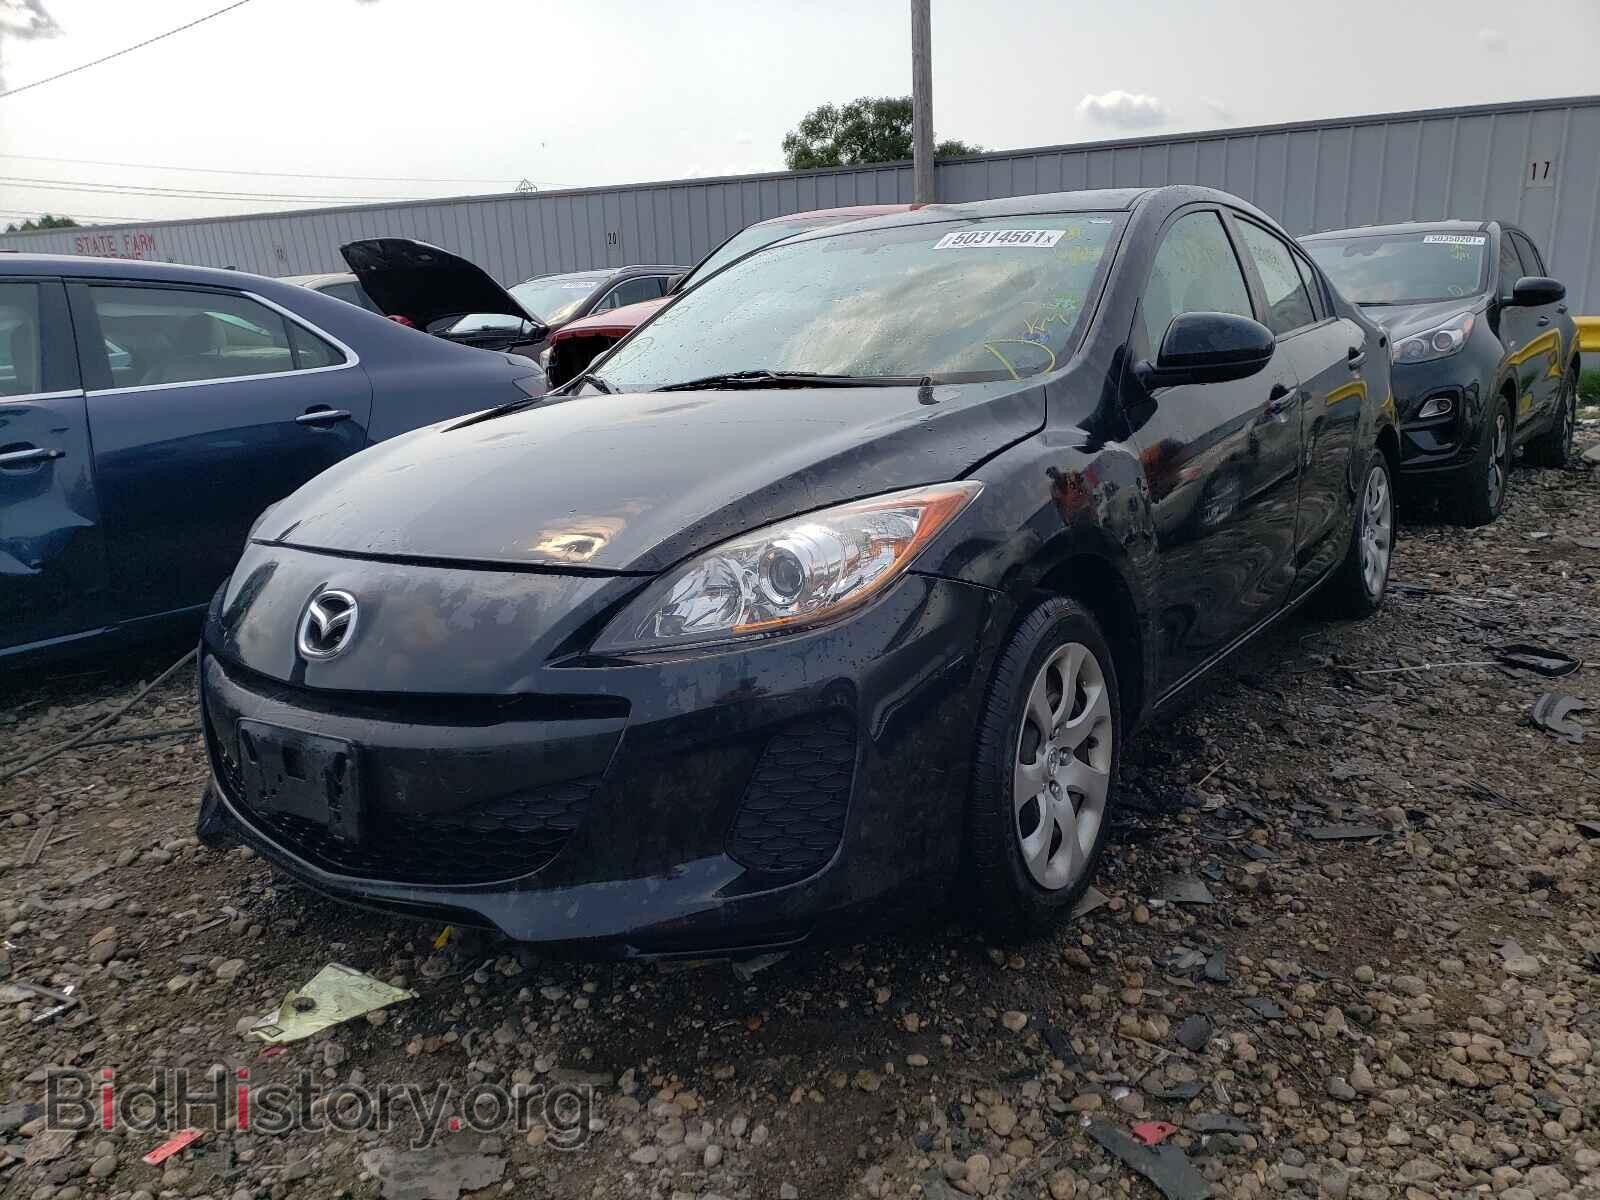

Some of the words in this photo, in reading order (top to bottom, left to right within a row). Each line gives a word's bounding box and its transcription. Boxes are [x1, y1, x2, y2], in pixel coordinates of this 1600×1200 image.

[1531, 160, 1551, 181] 17
[75, 235, 114, 253] STATE
[123, 234, 156, 251] FARM
[607, 231, 617, 245] 20
